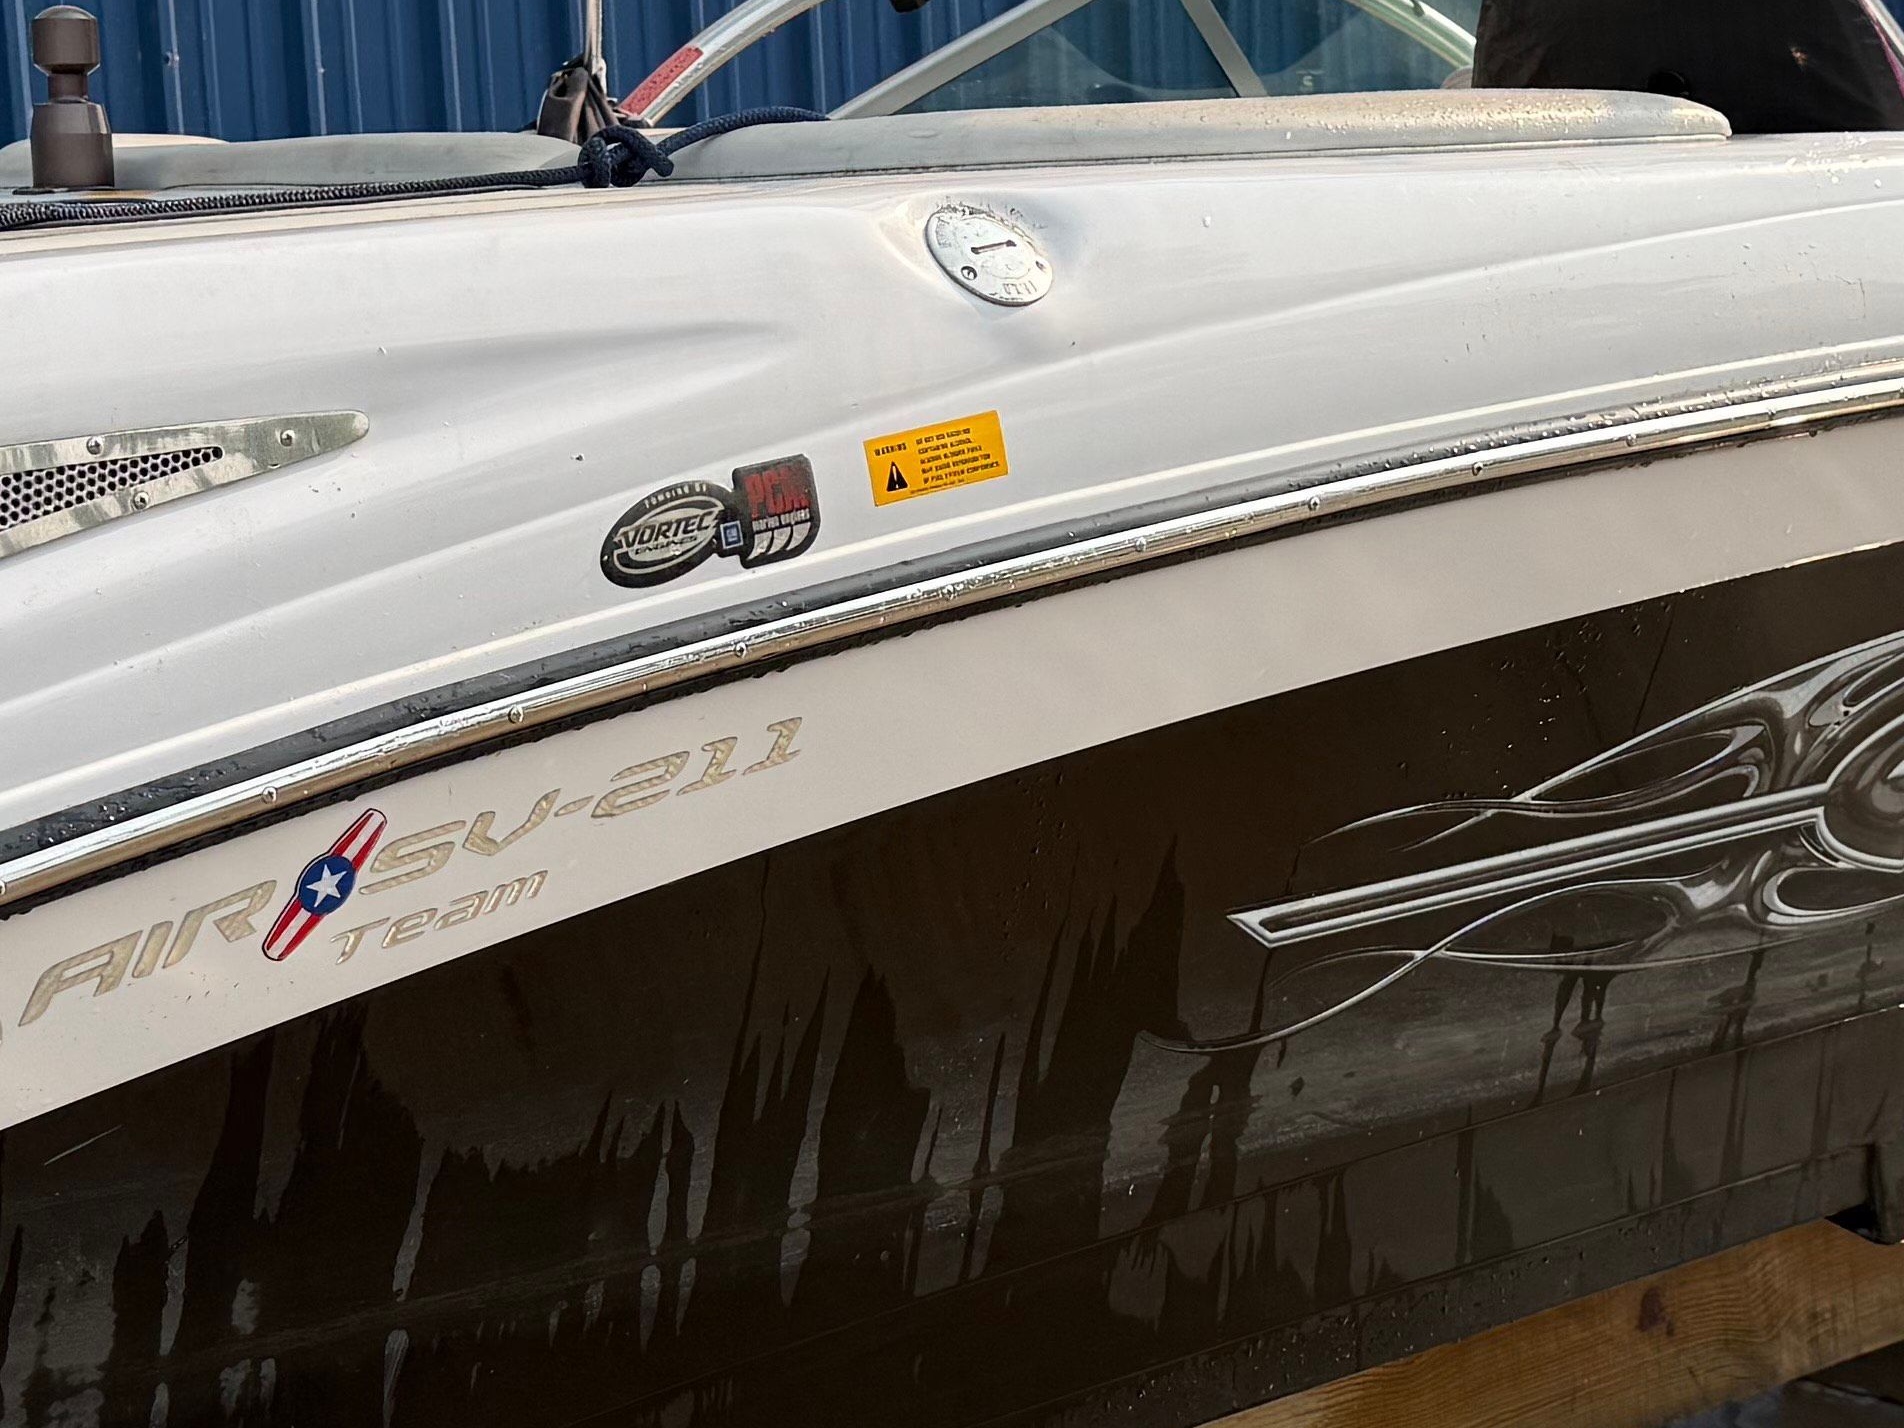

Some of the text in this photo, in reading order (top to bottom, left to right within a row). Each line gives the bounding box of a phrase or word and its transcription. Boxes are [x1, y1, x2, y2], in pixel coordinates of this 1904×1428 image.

[618, 510, 716, 549] VORTEC
[18, 716, 804, 1027] AIR SV-211
